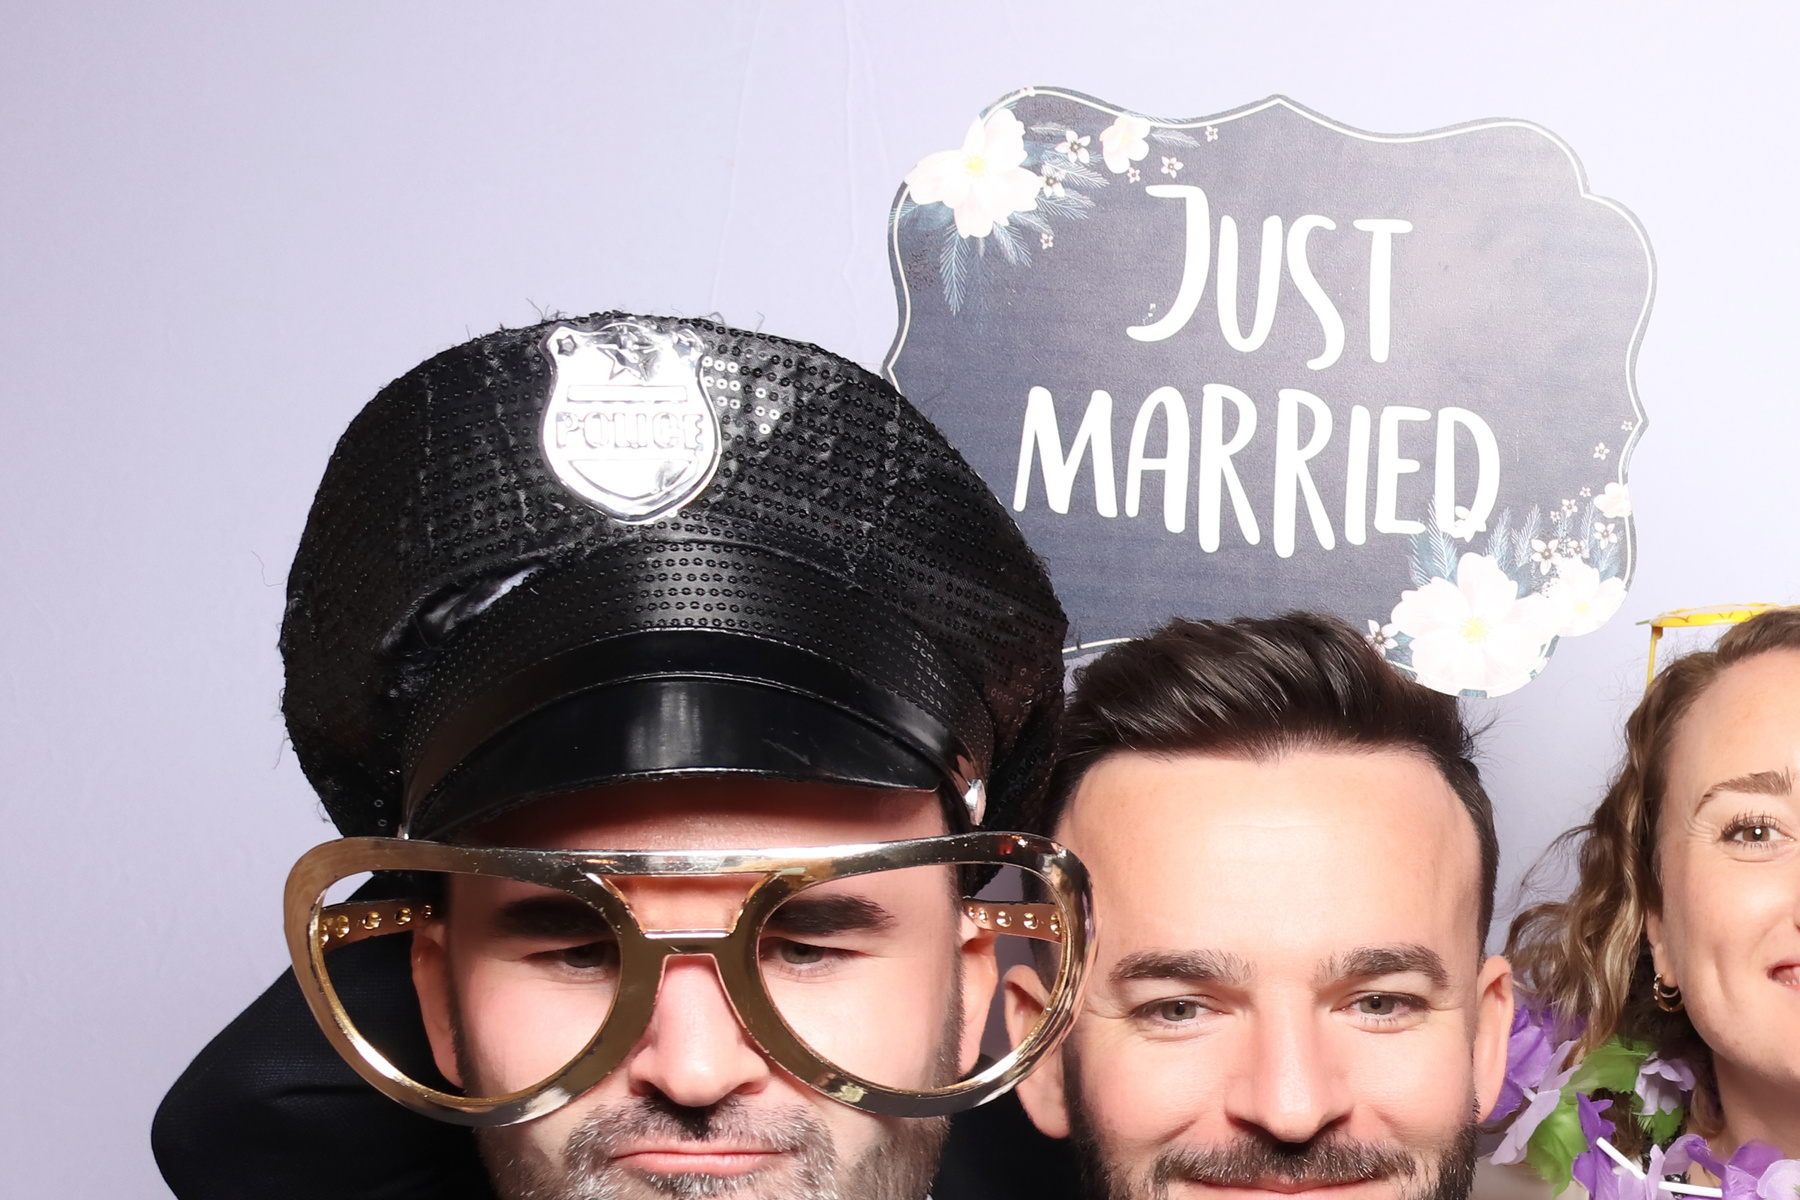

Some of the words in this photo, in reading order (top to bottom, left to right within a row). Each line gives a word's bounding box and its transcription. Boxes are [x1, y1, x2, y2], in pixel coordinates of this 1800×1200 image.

[1126, 184, 1414, 371] JUST
[556, 411, 704, 451] POLICE
[1012, 383, 1501, 559] MARRIED
